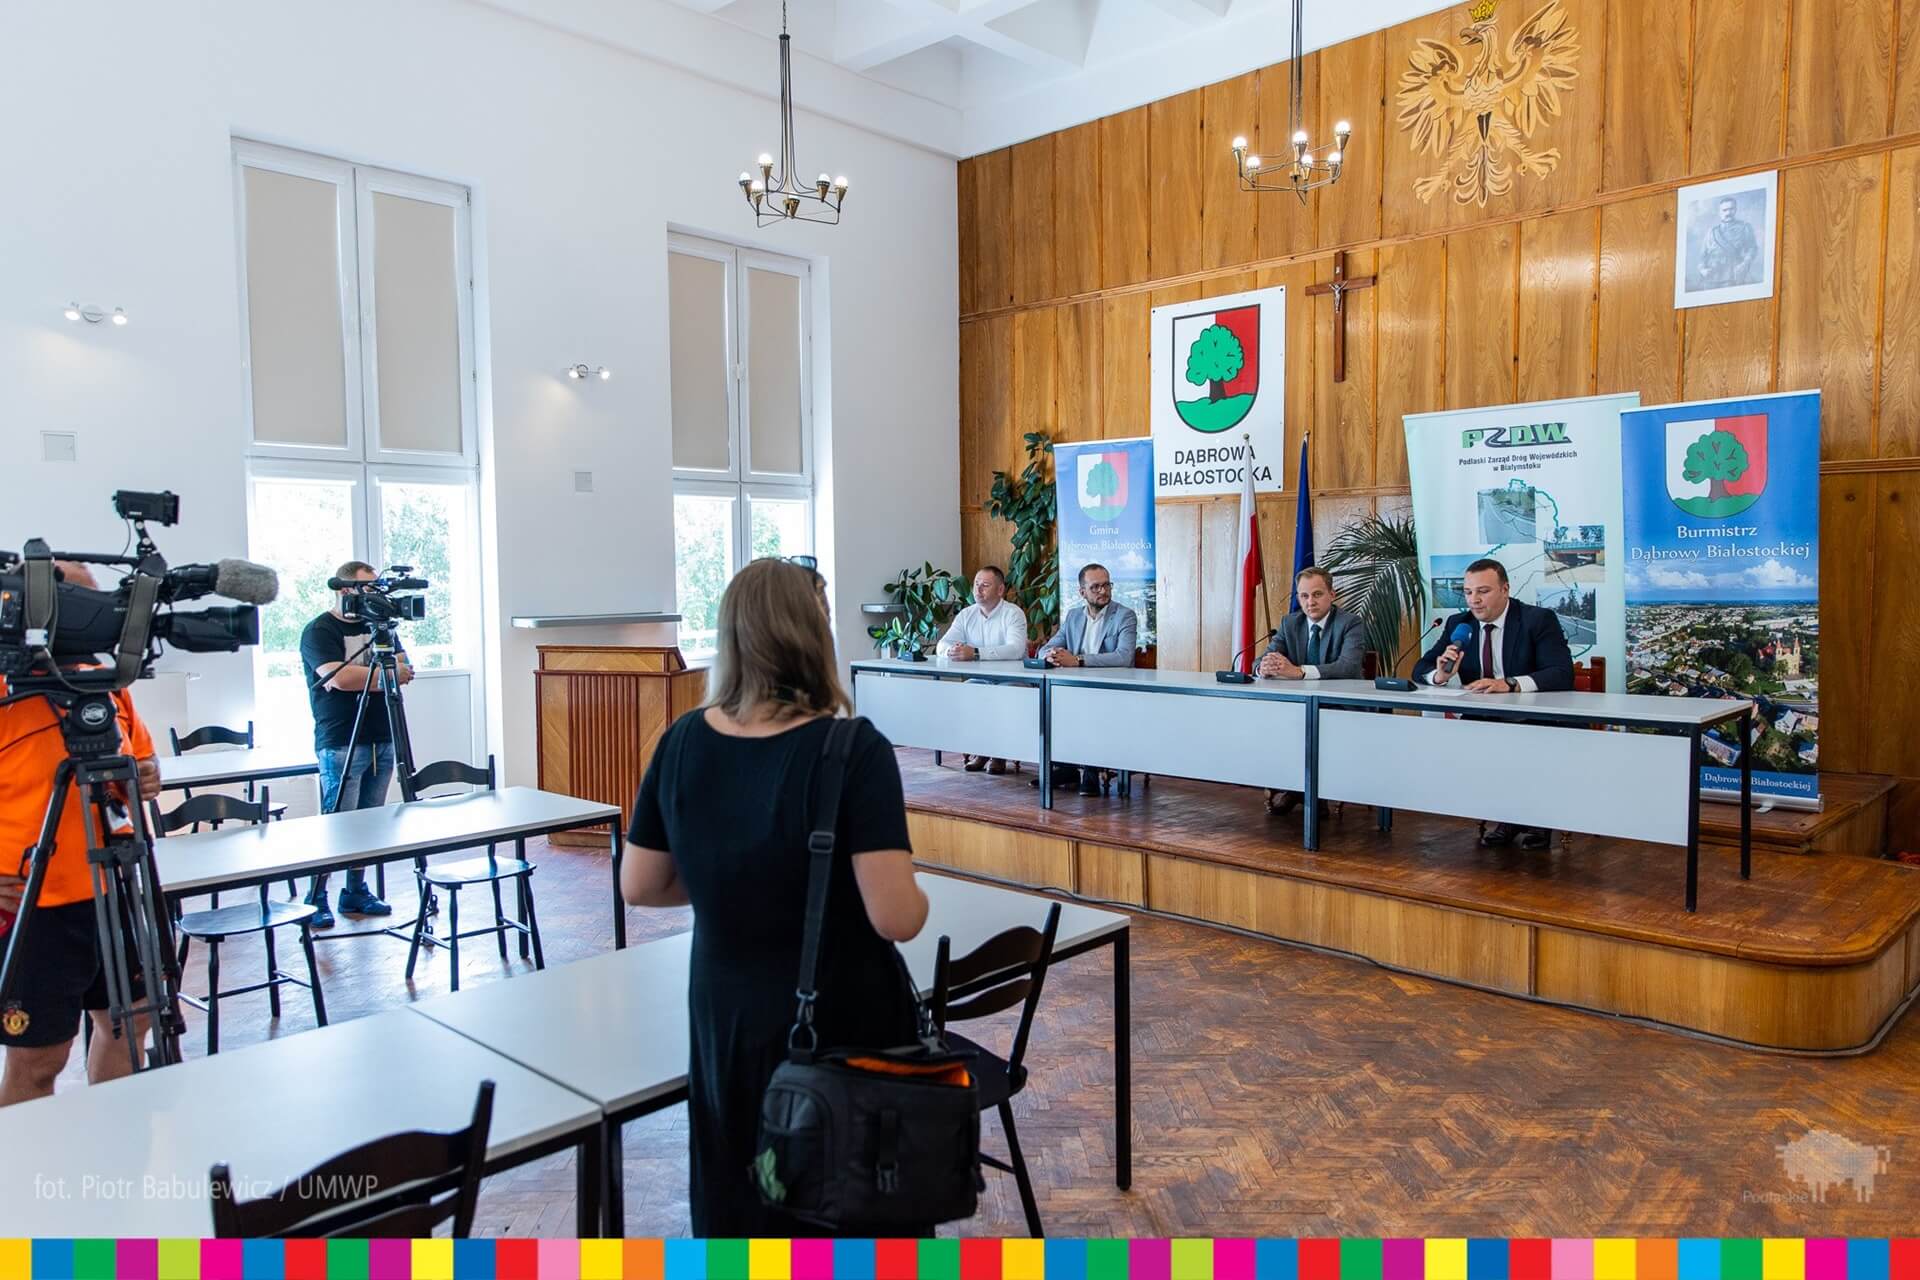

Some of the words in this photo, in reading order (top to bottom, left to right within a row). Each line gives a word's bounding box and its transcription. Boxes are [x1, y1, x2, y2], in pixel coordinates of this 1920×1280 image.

[1459, 457, 1487, 465] Podlaski
[1488, 454, 1510, 464] Zarząd
[1089, 526, 1119, 535] Gmina
[1677, 525, 1757, 539] Burmistrz
[1632, 546, 1701, 563] Dąbrowy
[1707, 541, 1810, 560] Białostockiej
[1705, 773, 1742, 784] Dąbrow
[1751, 777, 1811, 791] Białostockiej
